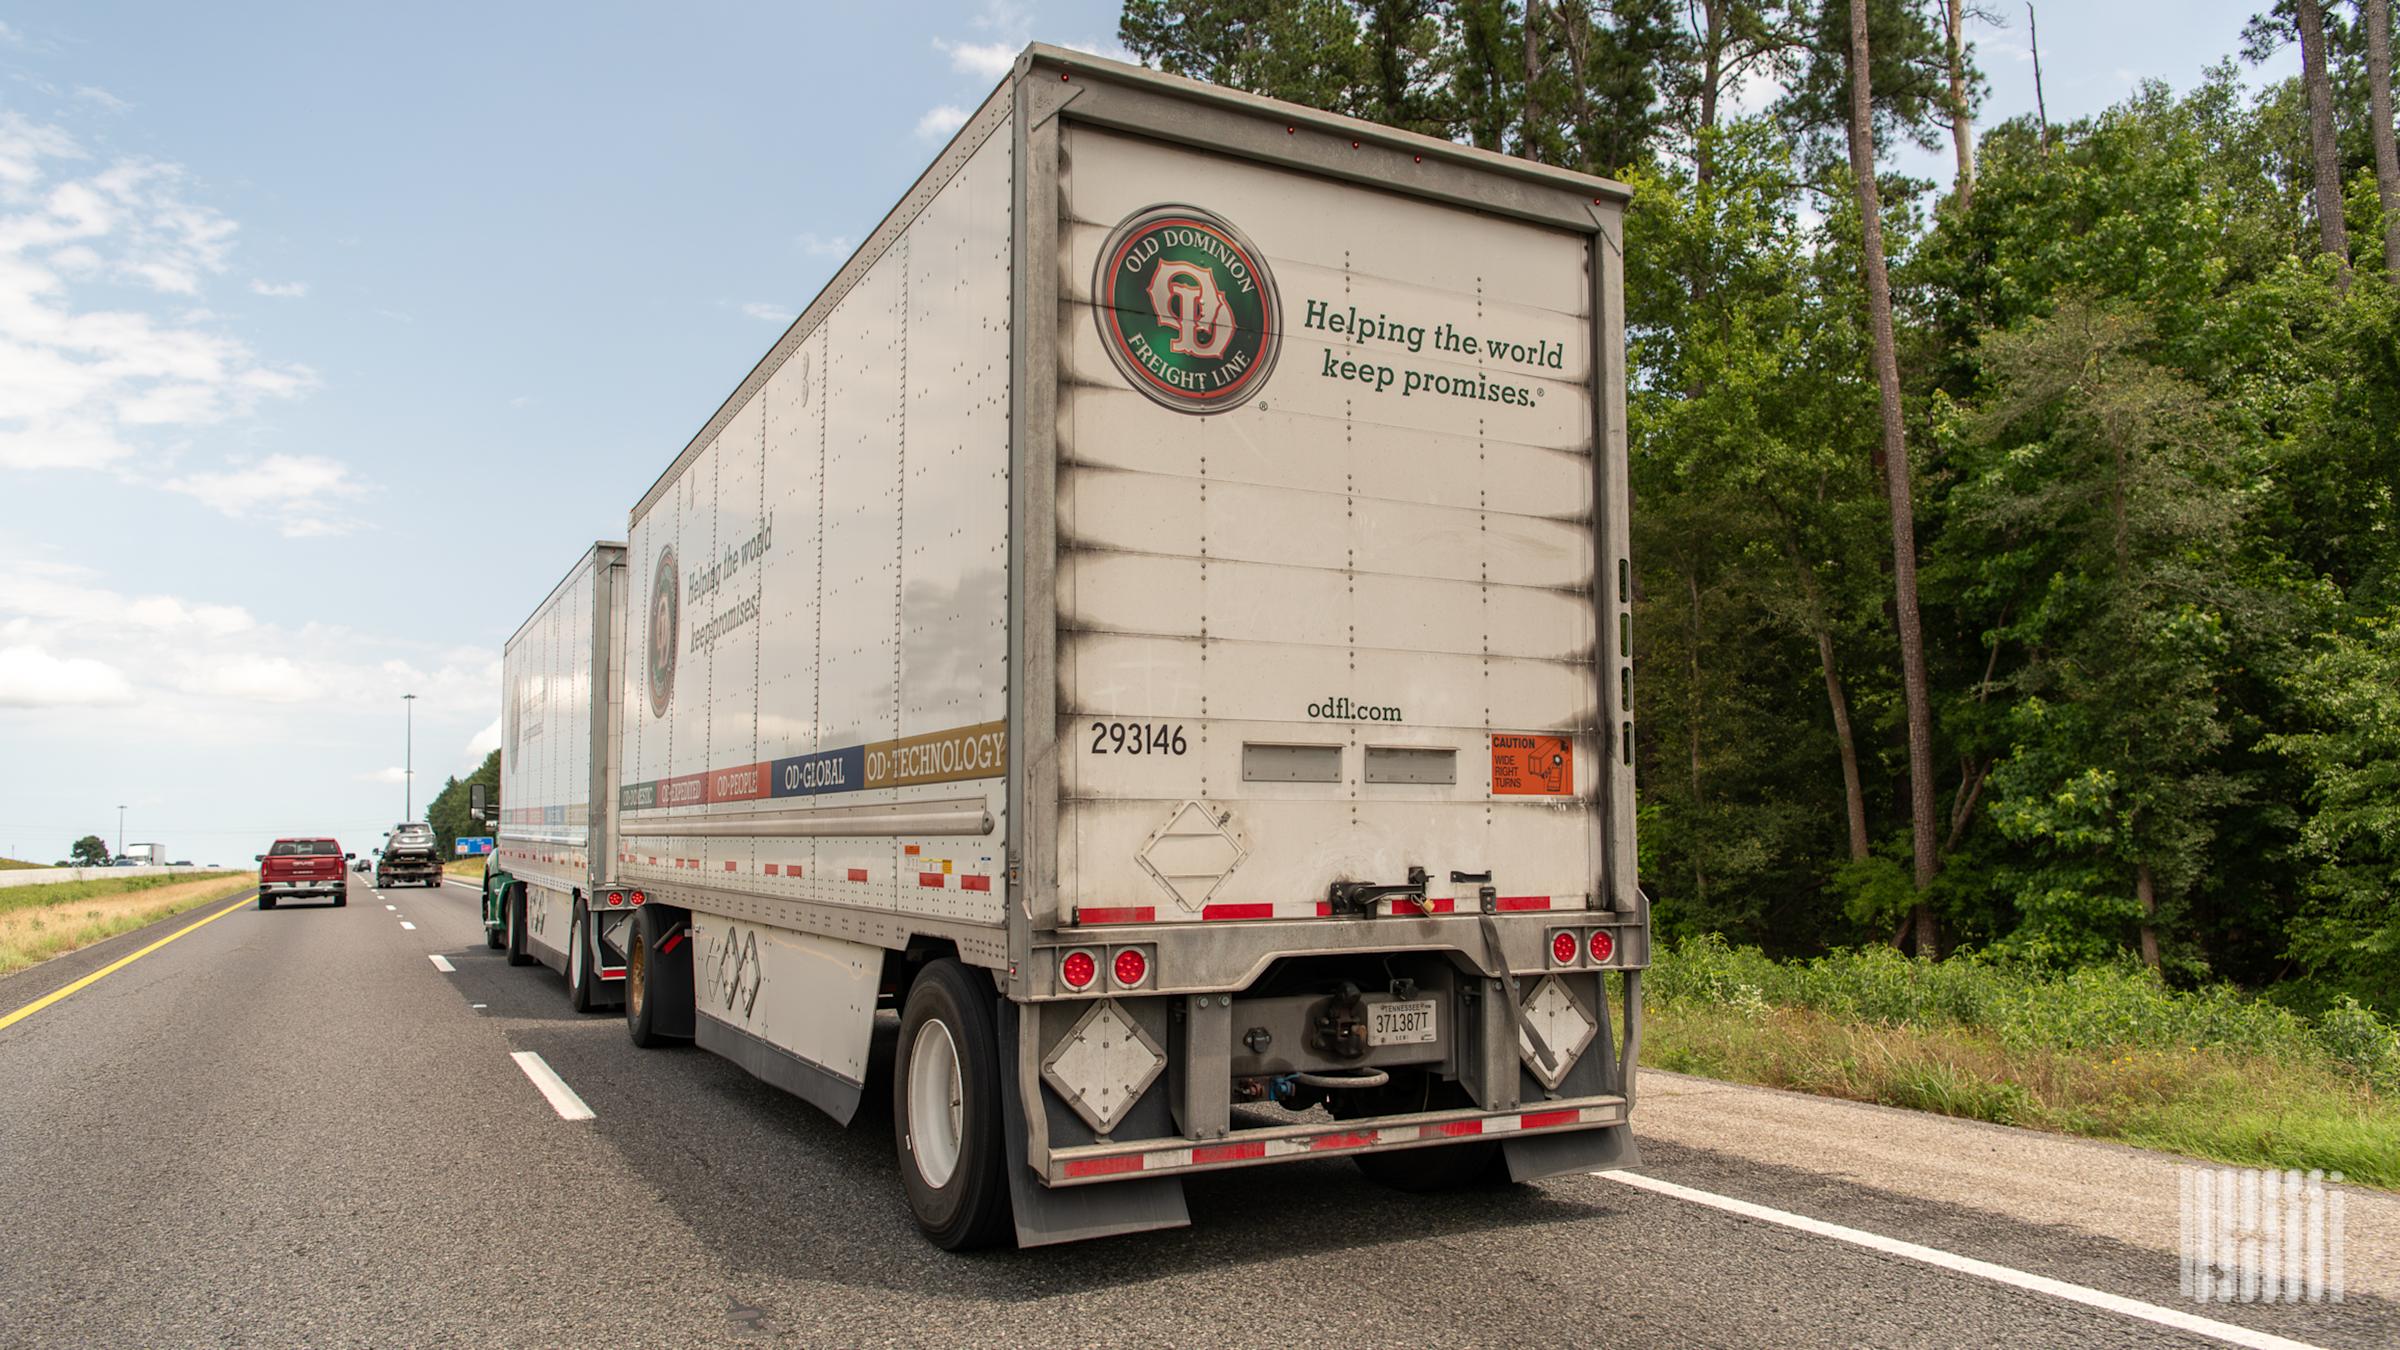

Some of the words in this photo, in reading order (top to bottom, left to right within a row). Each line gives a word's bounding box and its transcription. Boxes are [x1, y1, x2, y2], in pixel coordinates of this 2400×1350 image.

[1125, 237, 1159, 273] OLD
[1163, 229, 1255, 293] DOMINION
[1304, 299, 1426, 353] Helping
[1434, 323, 1478, 355] the
[1486, 339, 1564, 369] world
[1128, 332, 1207, 389] FREIGHT
[1211, 350, 1250, 387] LINE
[1321, 348, 1395, 393] keep
[687, 561, 722, 606] Helping
[723, 543, 739, 581] the
[740, 511, 773, 568] world
[690, 621, 711, 657] keep
[1306, 697, 1403, 722] odfl.com
[1090, 721, 1188, 756] 293146
[1493, 737, 1535, 748] CAUTION
[1495, 755, 1514, 765] WIDE
[1495, 766, 1518, 776] RIGHT
[1495, 777, 1521, 787] TURNS
[1376, 1012, 1428, 1033] 371387T
[1384, 1004, 1420, 1012] TENNESSEE
